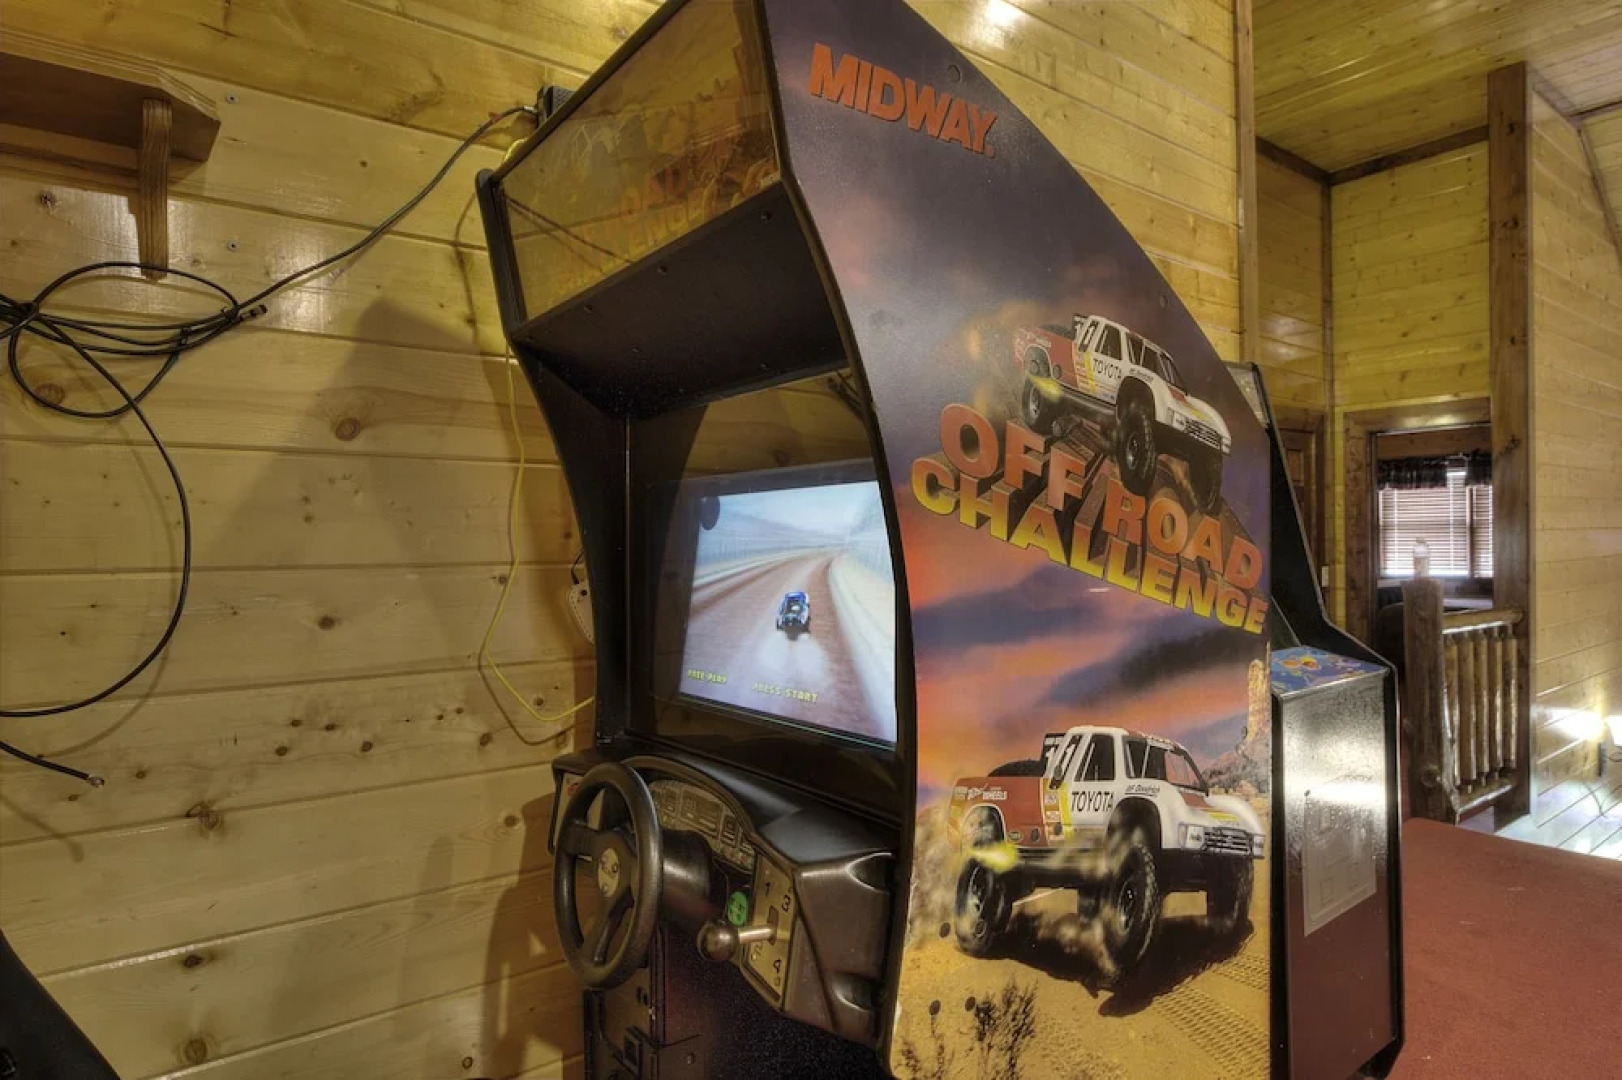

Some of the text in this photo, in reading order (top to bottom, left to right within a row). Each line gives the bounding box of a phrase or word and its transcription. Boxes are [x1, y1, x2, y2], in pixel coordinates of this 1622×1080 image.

[1093, 357, 1122, 379] TOYOTA
[940, 402, 1263, 589] OFF ROAD
[911, 456, 1269, 634] CHALLENGE
[782, 688, 818, 702] START
[1071, 790, 1116, 812] TOYOTA
[781, 894, 791, 912] 3
[773, 959, 782, 974] 4
